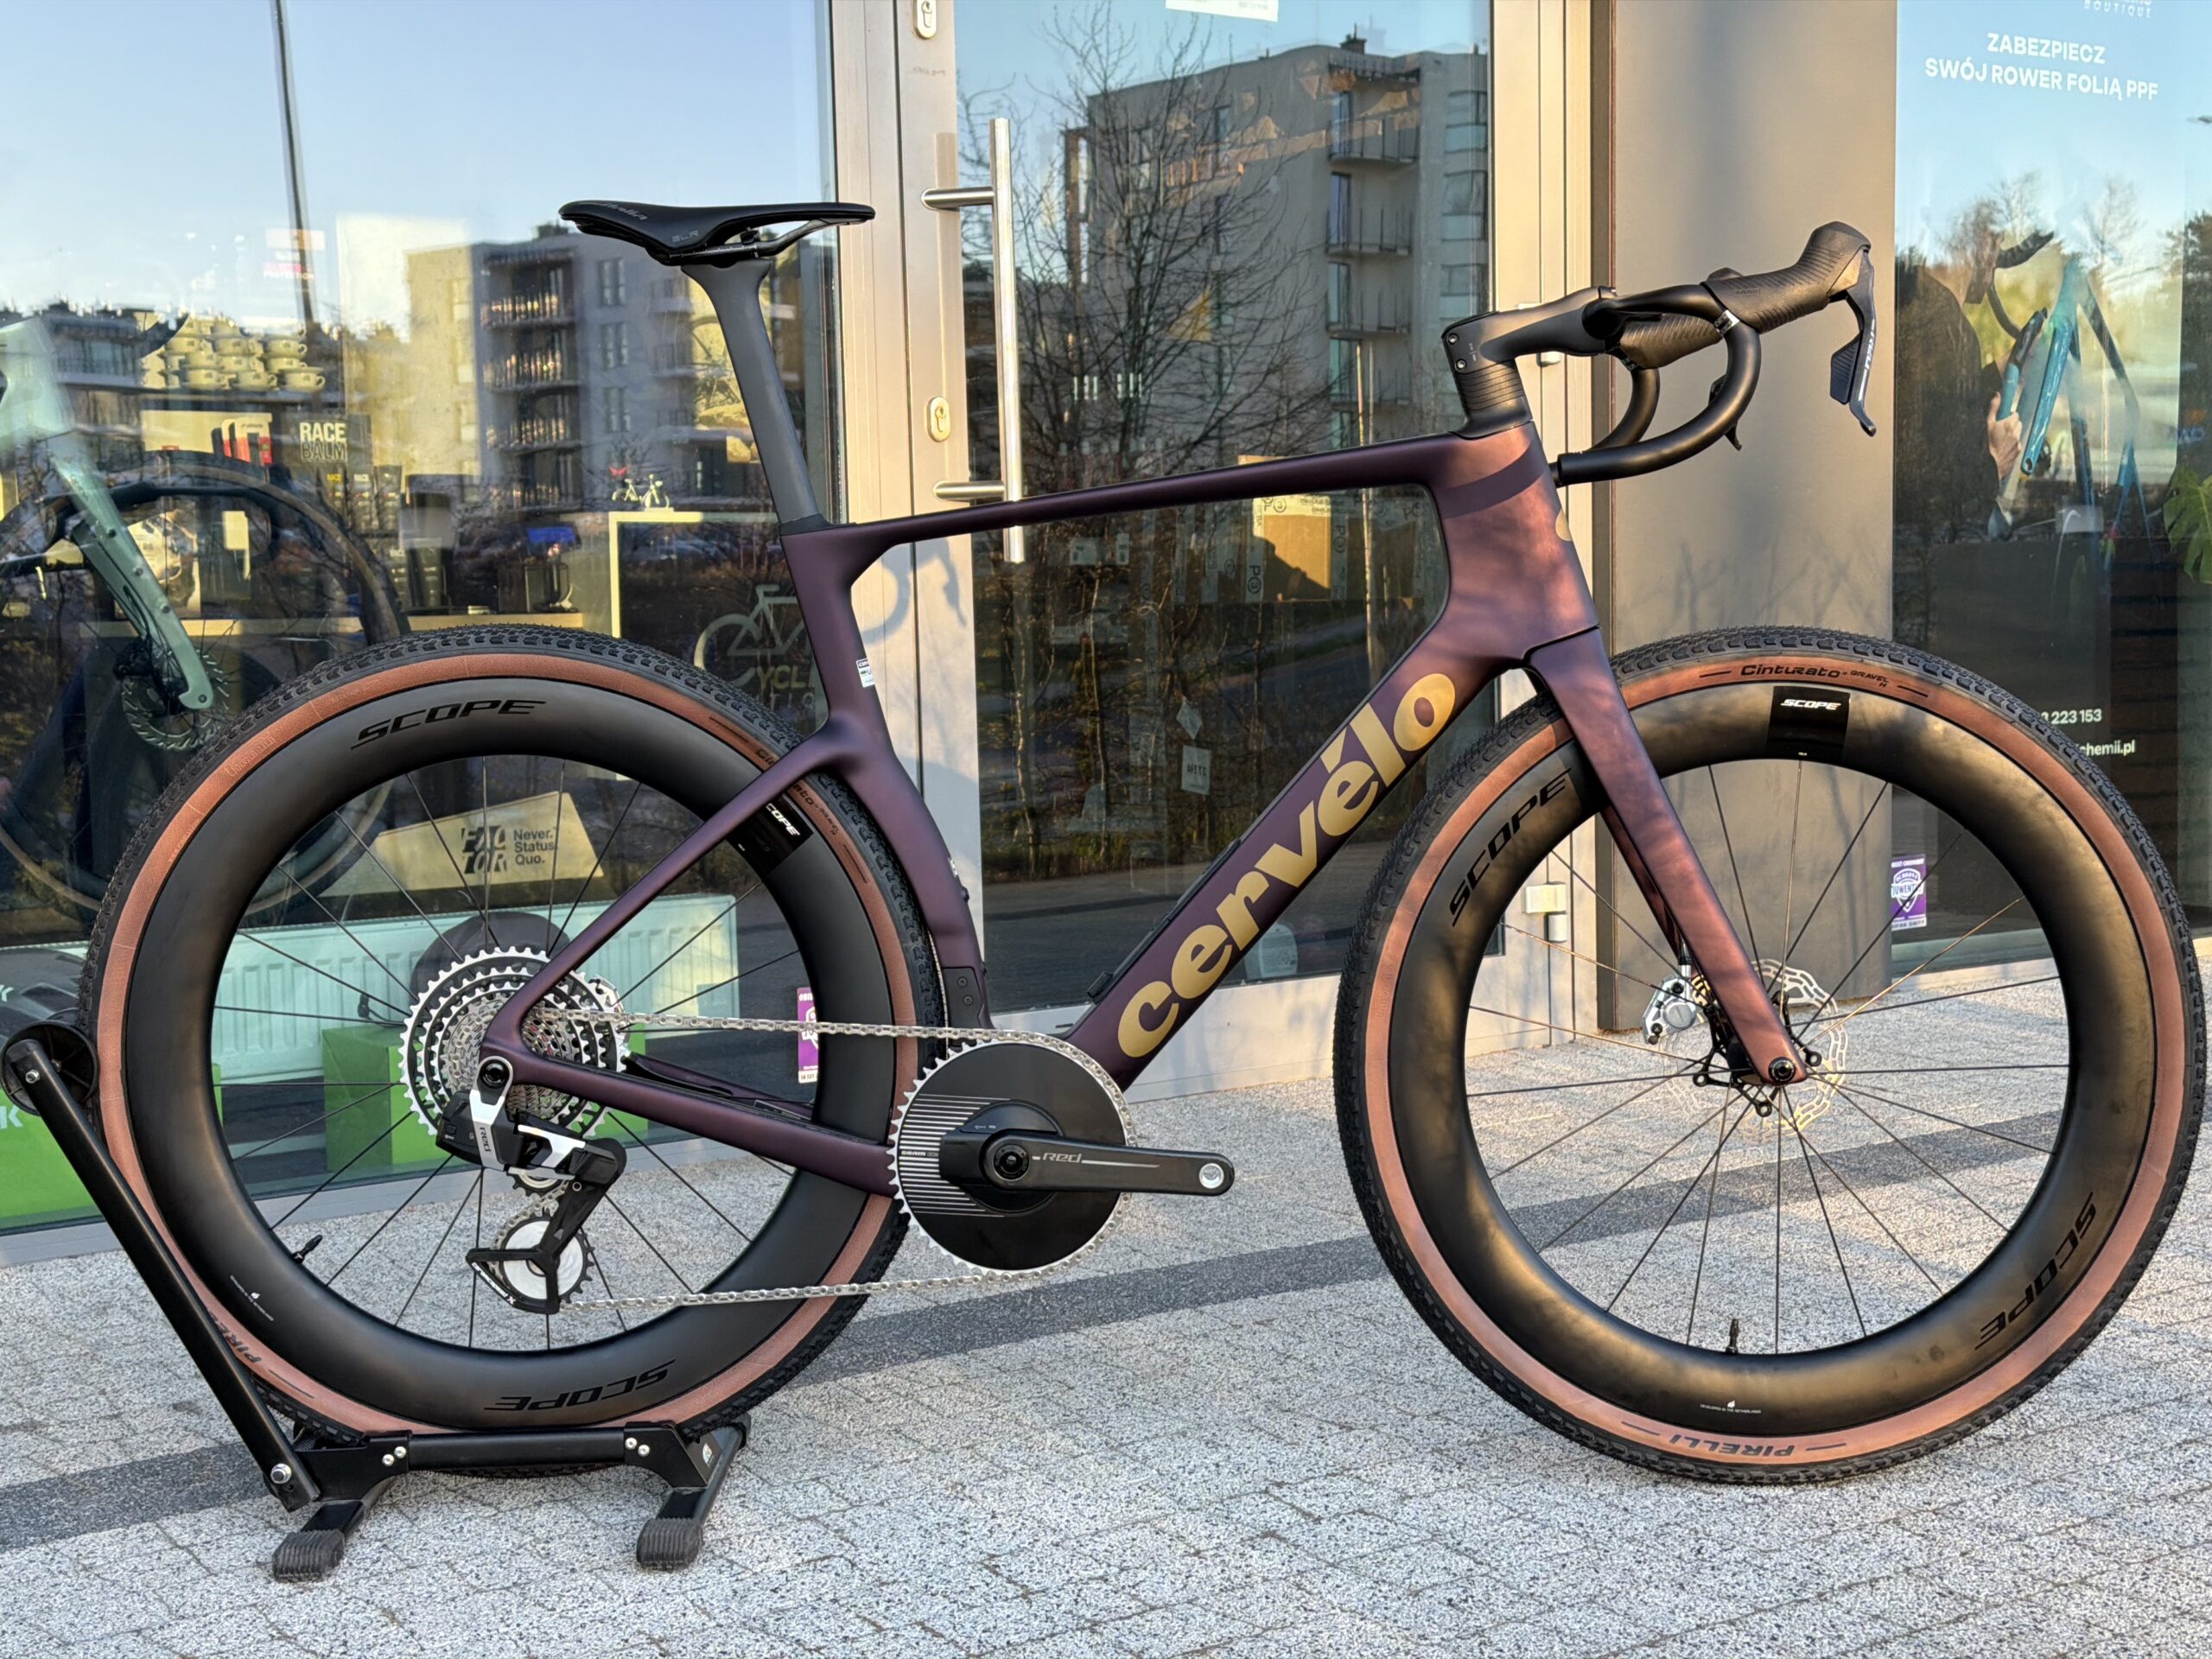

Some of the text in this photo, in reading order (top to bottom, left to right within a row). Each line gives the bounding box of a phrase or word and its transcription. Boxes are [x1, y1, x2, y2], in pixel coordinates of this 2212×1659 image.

[2084, 0, 2151, 17] BOUTIQUE
[1987, 33, 2106, 64] ZABEZPIECZ
[1924, 56, 2159, 101] SWÓJ ROWER FOLIĄ PPF
[300, 422, 346, 442] RACE
[301, 442, 347, 461] BALM
[1741, 664, 1841, 678] Cinturato
[1780, 698, 1841, 710] SCOPE
[2050, 710, 2078, 724] 223
[2079, 709, 2102, 723] 153
[351, 700, 546, 750] SCOPE
[766, 803, 800, 836] COPE
[513, 829, 553, 841] Never.
[1449, 767, 1572, 927] SCOPE
[514, 854, 545, 866] Quo.
[1118, 673, 1456, 1058] cervélo
[1974, 1192, 2097, 1351] SCOPE
[484, 1359, 676, 1411] SCOPE
[1669, 1433, 1796, 1458] PIRELLI
